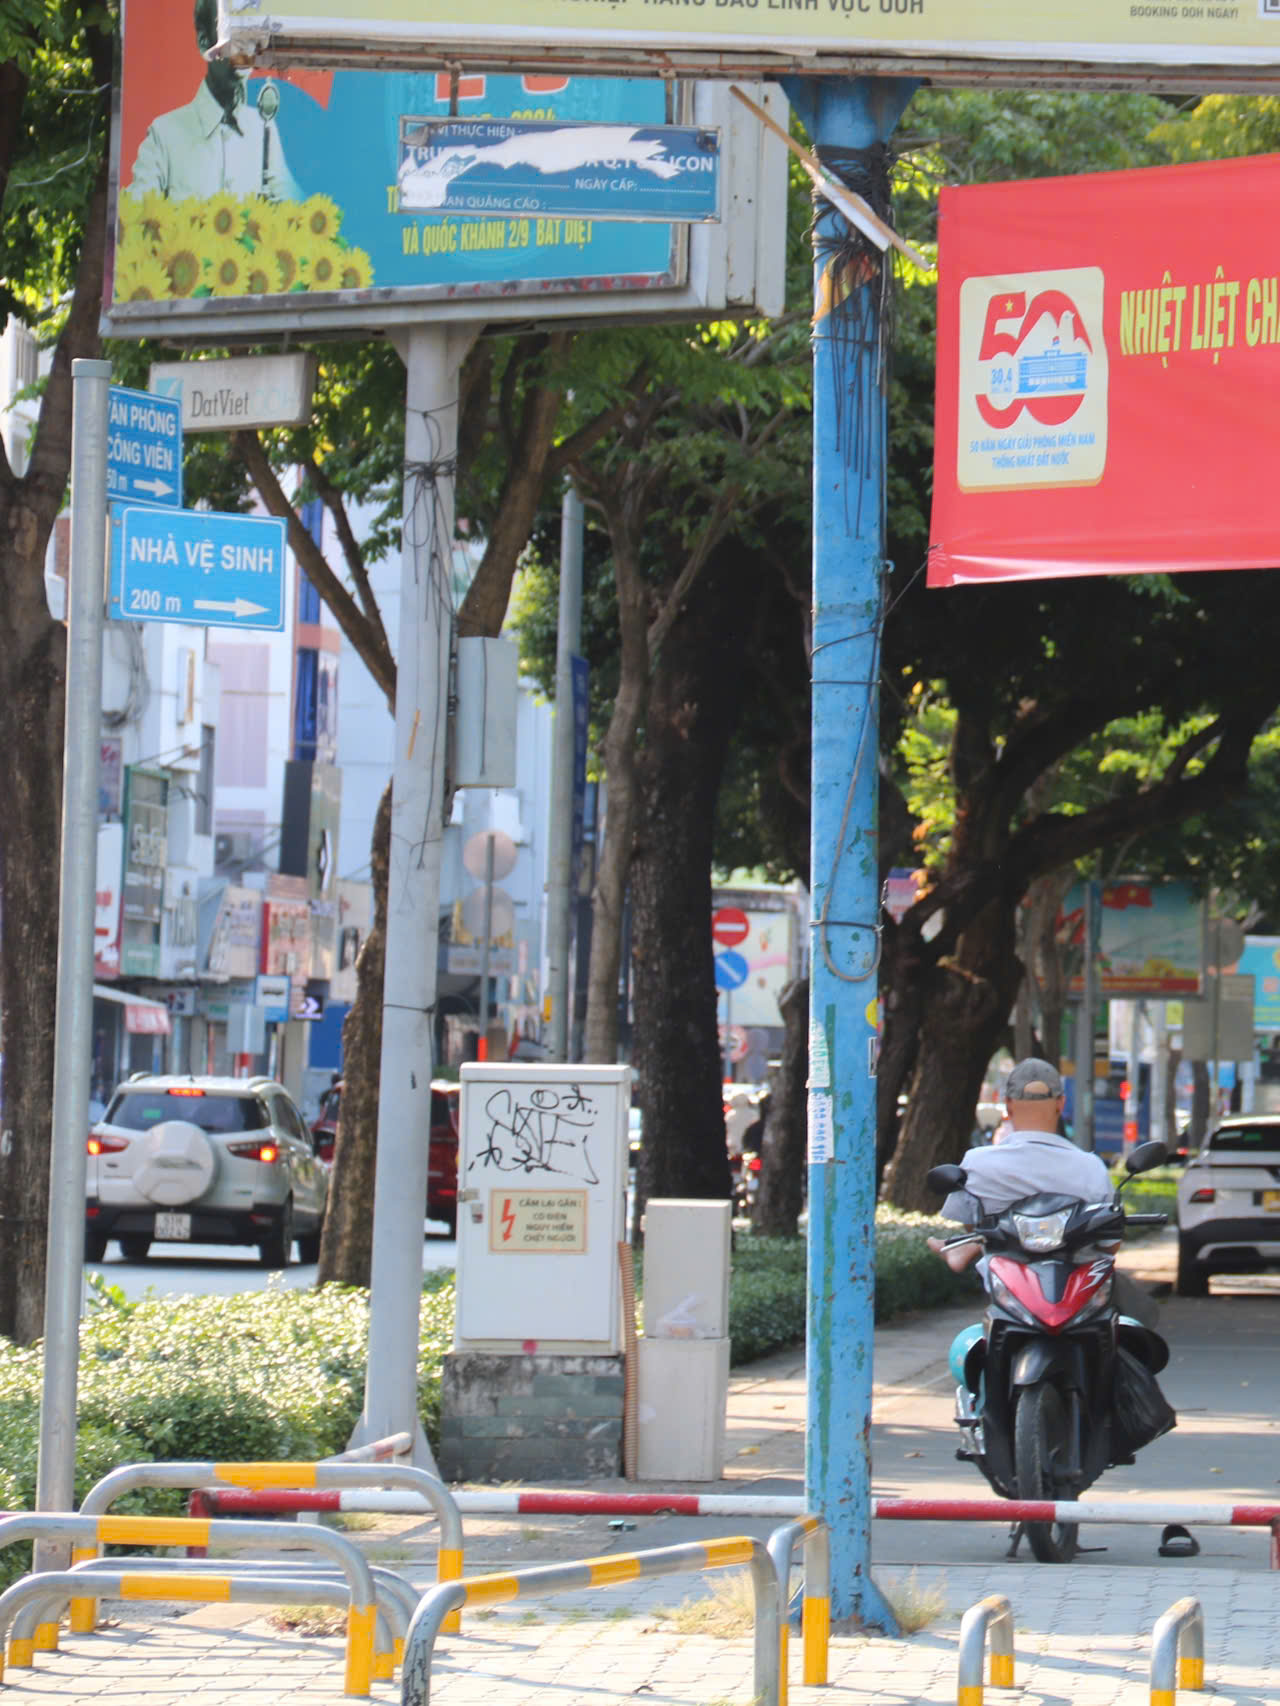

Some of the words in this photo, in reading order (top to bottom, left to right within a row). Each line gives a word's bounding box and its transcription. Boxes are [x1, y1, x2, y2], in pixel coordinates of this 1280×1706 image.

[1130, 7, 1178, 20] BOOKING
[575, 178, 607, 191] NGÀY
[467, 193, 511, 209] QUẢNG
[460, 216, 505, 251] KHÁNH
[509, 220, 529, 248] 2/9
[1120, 271, 1187, 368] NHIỆT
[1191, 266, 1240, 364] LIỆT
[191, 388, 249, 417] DatViet
[130, 403, 176, 437] PHÒNG
[144, 440, 173, 472] VIÊN
[130, 532, 180, 566] NHÀ
[184, 539, 215, 574] VỆ
[221, 545, 274, 574] SINH
[130, 589, 162, 612] 200
[165, 597, 181, 613] m
